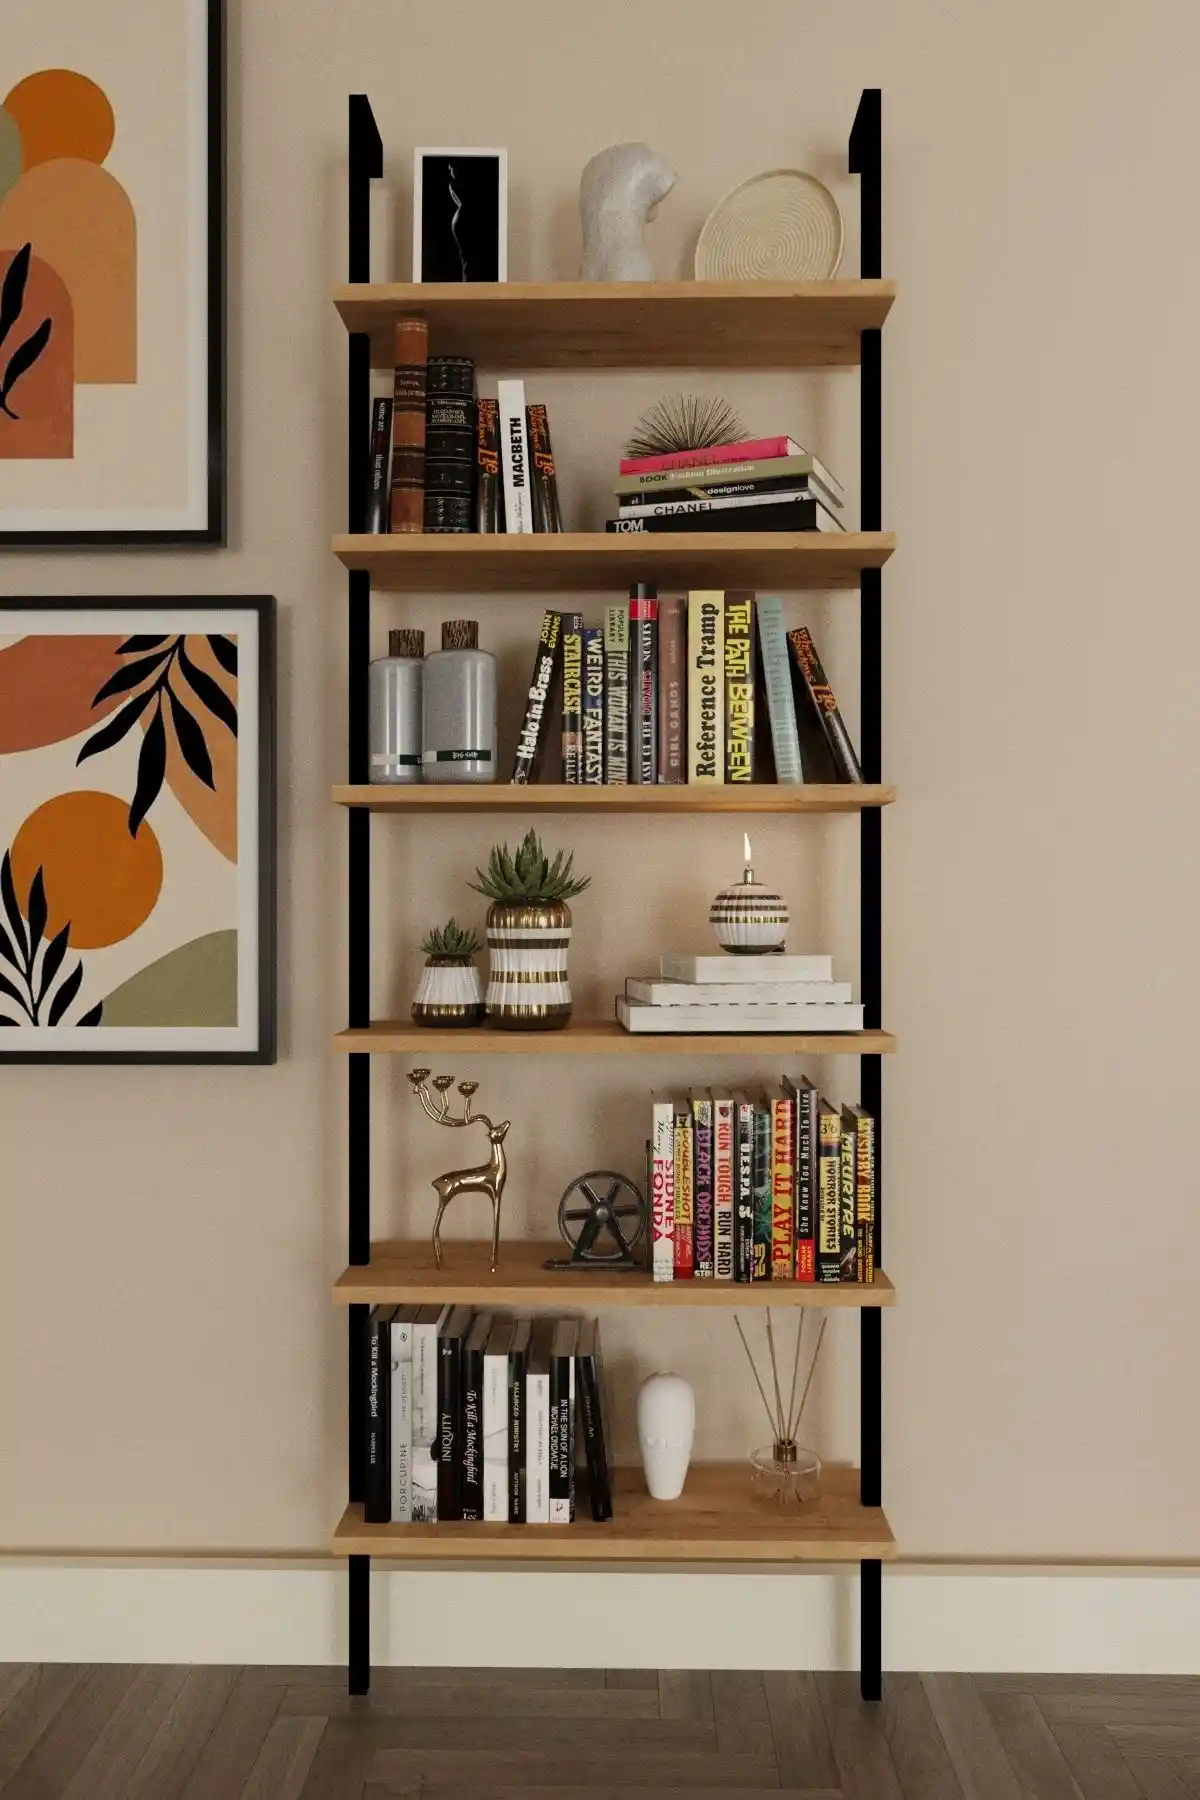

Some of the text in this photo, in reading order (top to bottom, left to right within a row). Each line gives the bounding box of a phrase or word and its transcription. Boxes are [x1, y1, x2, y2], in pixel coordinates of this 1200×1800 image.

[378, 402, 386, 420] some
[375, 454, 384, 468] than
[478, 448, 498, 474] Lie
[510, 418, 524, 487] MACBETH
[535, 451, 554, 475] Lie
[614, 519, 643, 532] TOM
[540, 614, 553, 644] JOHN
[548, 616, 560, 649] EVANS
[608, 609, 616, 643] LIBRARY
[562, 634, 581, 714] STAIRCASE
[608, 652, 627, 680] THIS
[696, 603, 719, 777] Reference Tramp
[725, 600, 754, 781] THE PATH BETWEEN
[516, 655, 554, 759] Halo in Brass
[583, 638, 602, 785] WEIRD FANTASY
[608, 686, 627, 732] WOMAN
[608, 738, 627, 752] IS
[642, 720, 651, 738] THE
[566, 744, 576, 784] REILLY
[670, 735, 679, 767] GIRL
[801, 1093, 809, 1113] Live
[775, 1100, 795, 1165] HARD
[801, 1119, 809, 1128] To
[696, 1128, 711, 1186] BLACK
[801, 1134, 809, 1159] Much
[857, 1118, 871, 1178] MYSTERY
[682, 1130, 690, 1221] DOUBLESHOT
[774, 1172, 792, 1196] IT
[801, 1165, 809, 1181] Too
[842, 1133, 854, 1238] MEURTRE
[653, 1159, 664, 1243] FONDA
[665, 1159, 674, 1242] SIDNEY
[716, 1123, 732, 1275] RUN TOUGH, RUN HARD
[827, 1161, 836, 1250] HORROR STORIES
[697, 1191, 711, 1262] ORCHIDS
[772, 1203, 792, 1261] PLAY
[800, 1216, 809, 1233] She
[371, 1335, 378, 1345] To
[369, 1368, 379, 1417] Mockingbird
[466, 1390, 477, 1402] To
[560, 1399, 568, 1407] IN
[466, 1404, 477, 1422] Kill
[560, 1408, 568, 1422] THE
[441, 1413, 454, 1462] INIQUITY
[550, 1406, 558, 1470] MICHAEL ONDAATJE
[560, 1425, 568, 1441] SKIN
[560, 1442, 568, 1452] OF
[463, 1430, 477, 1485] Mockingbird
